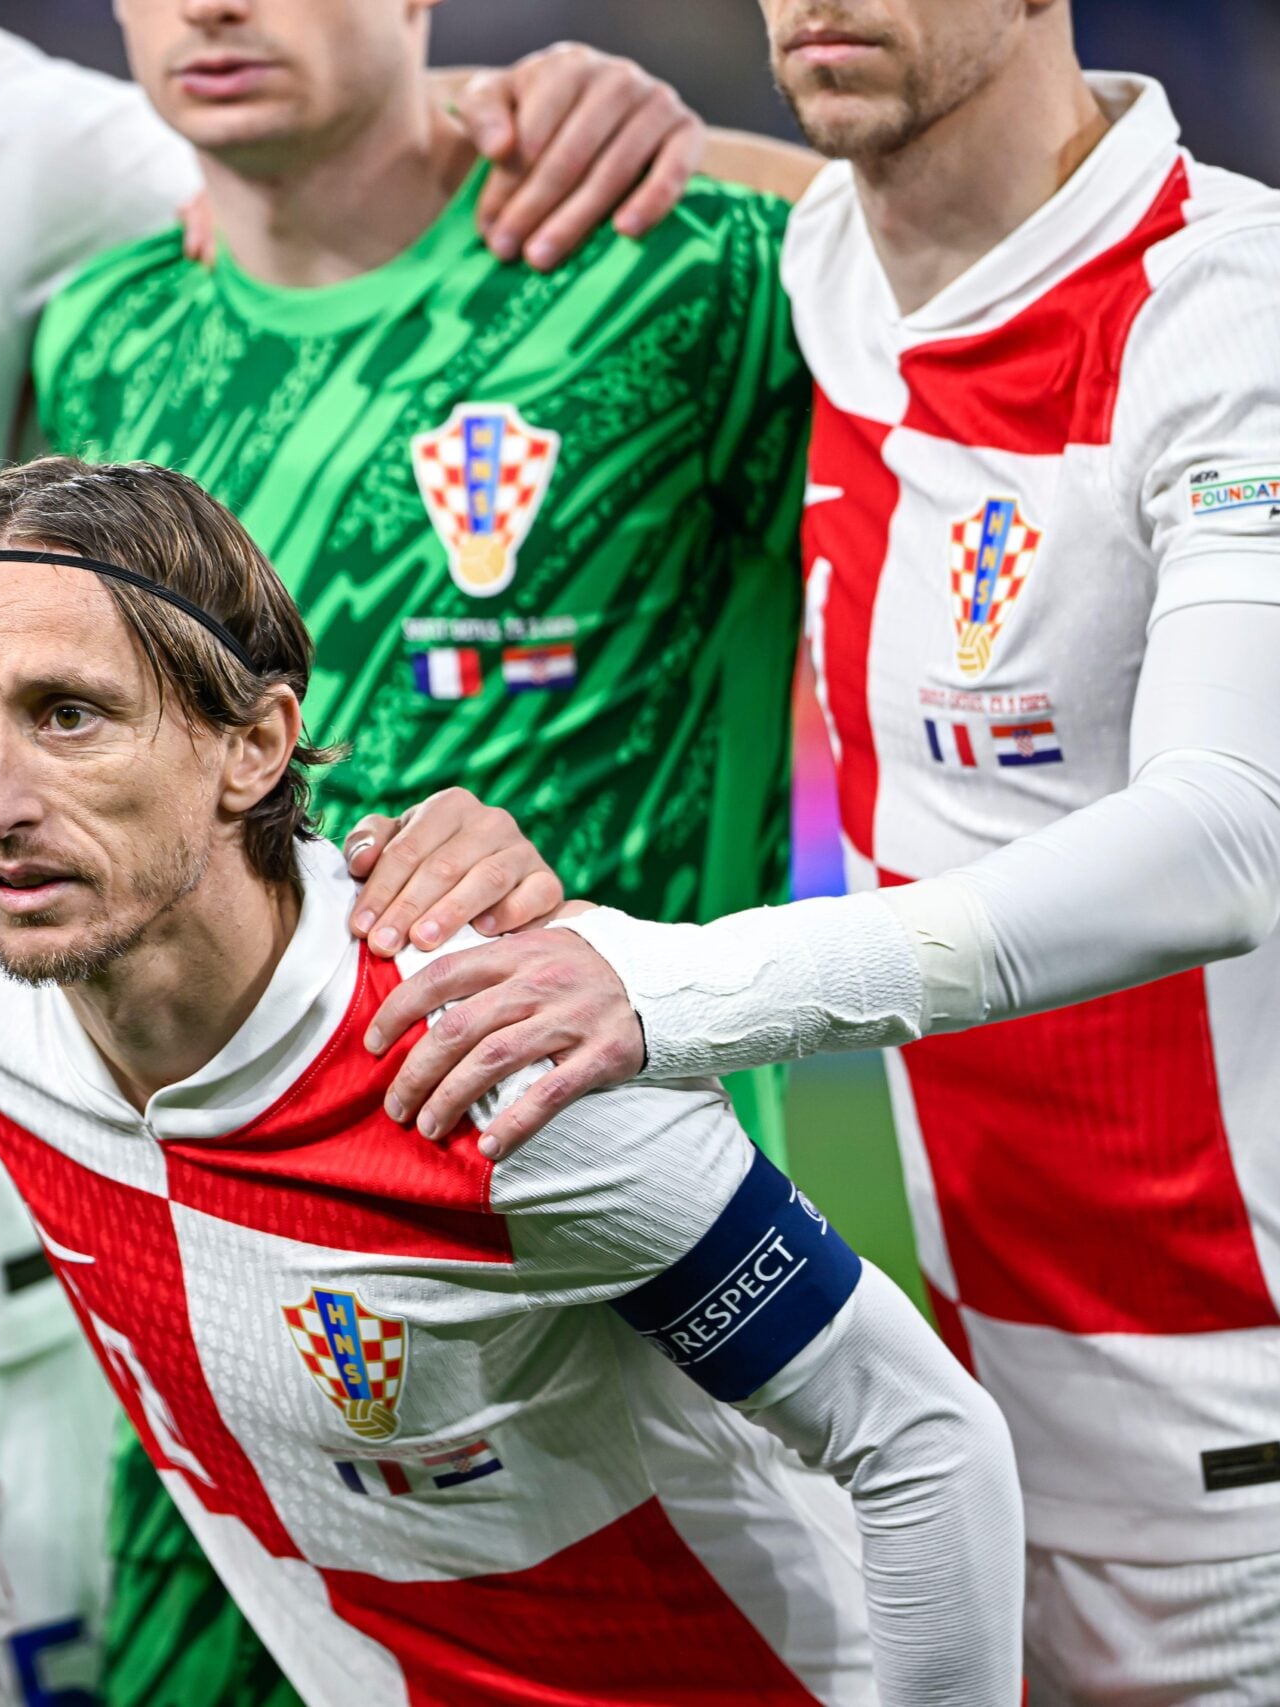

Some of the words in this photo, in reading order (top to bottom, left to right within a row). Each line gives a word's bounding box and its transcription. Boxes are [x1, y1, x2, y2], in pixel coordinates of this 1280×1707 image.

[977, 511, 1006, 605] HNS
[671, 1235, 795, 1354] RESPECT
[326, 1303, 363, 1385] HNS
